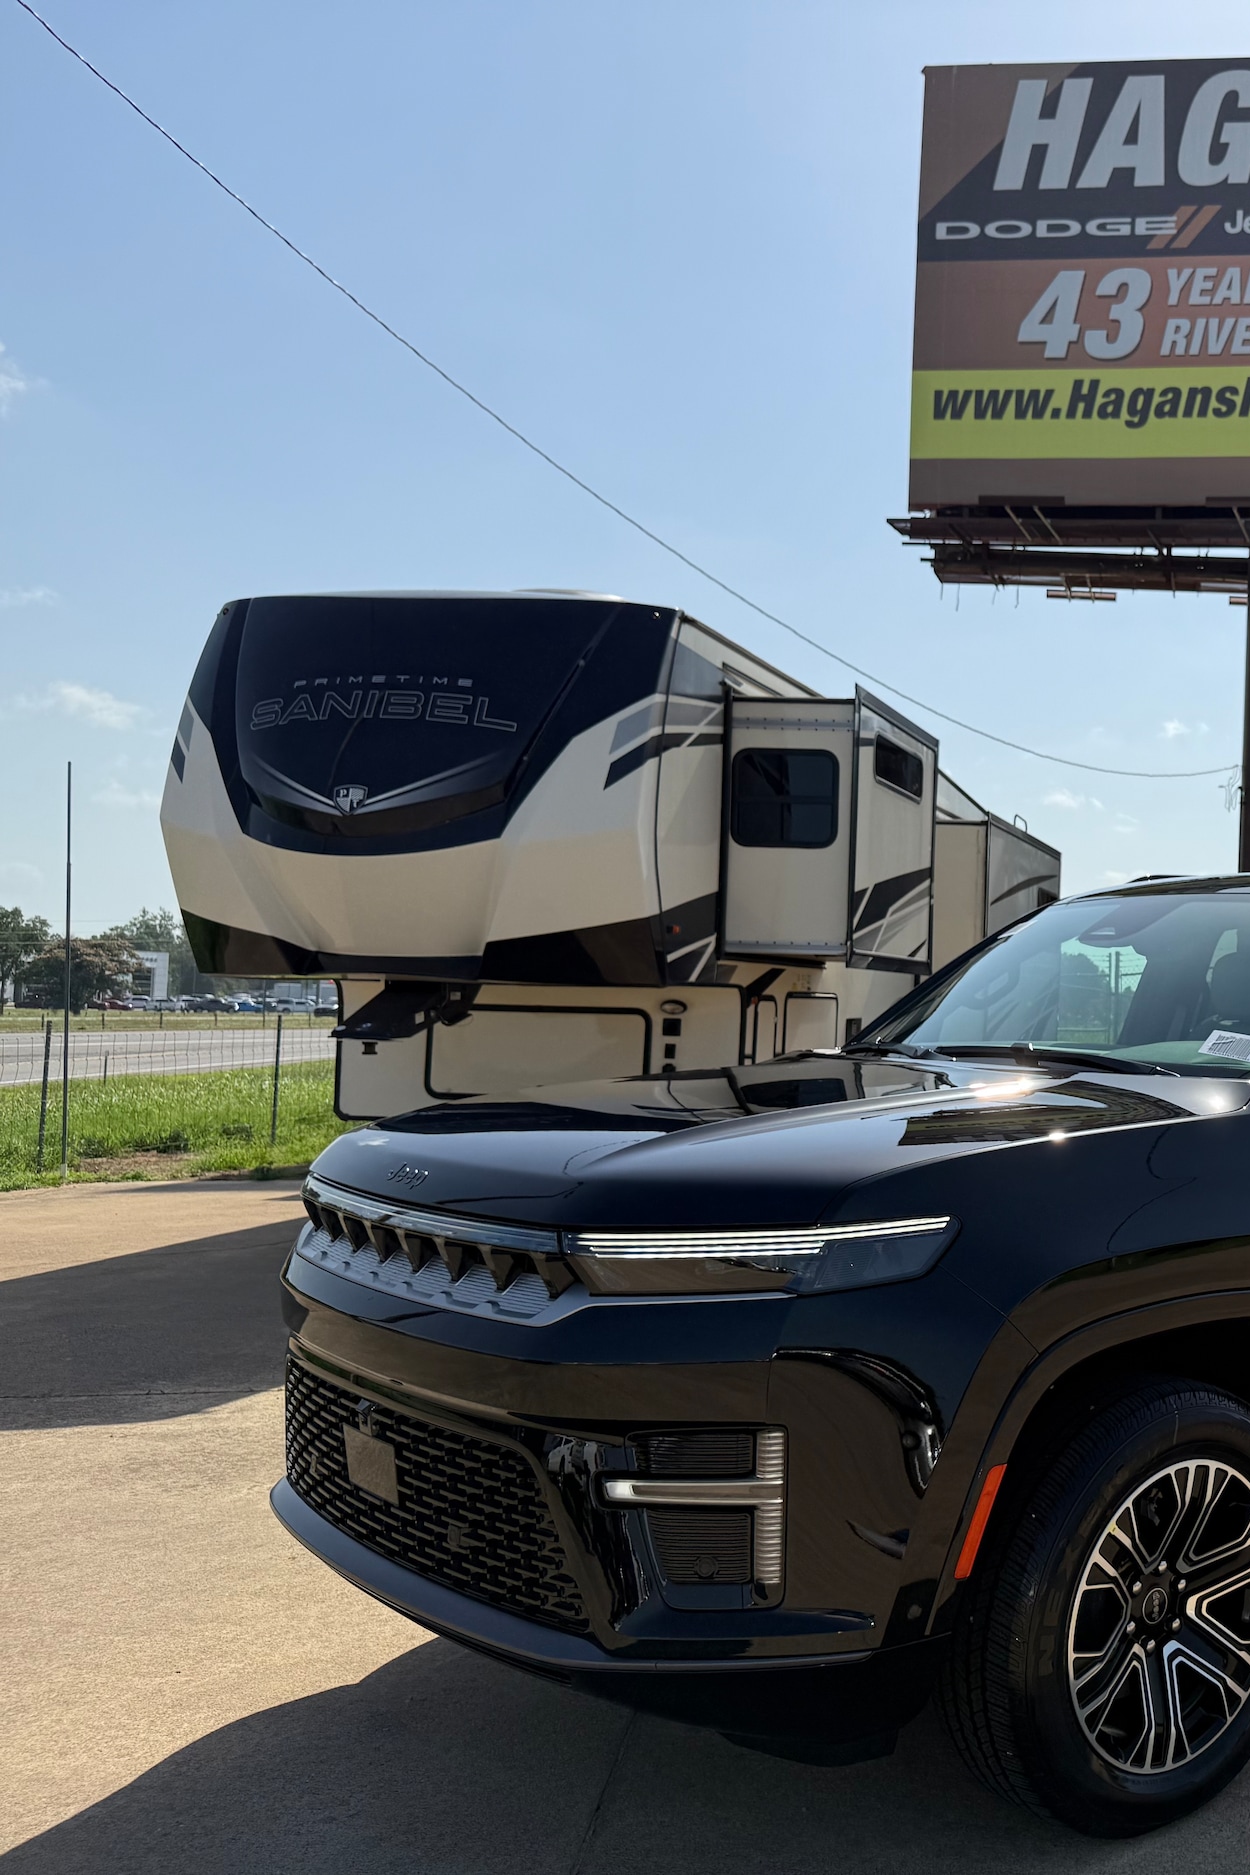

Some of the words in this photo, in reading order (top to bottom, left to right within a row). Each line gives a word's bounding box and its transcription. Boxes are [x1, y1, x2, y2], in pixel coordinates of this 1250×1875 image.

[935, 215, 1178, 240] DODGE
[1017, 267, 1151, 360] 43
[251, 691, 517, 732] SANIBEL
[387, 1162, 429, 1189] Jeep
